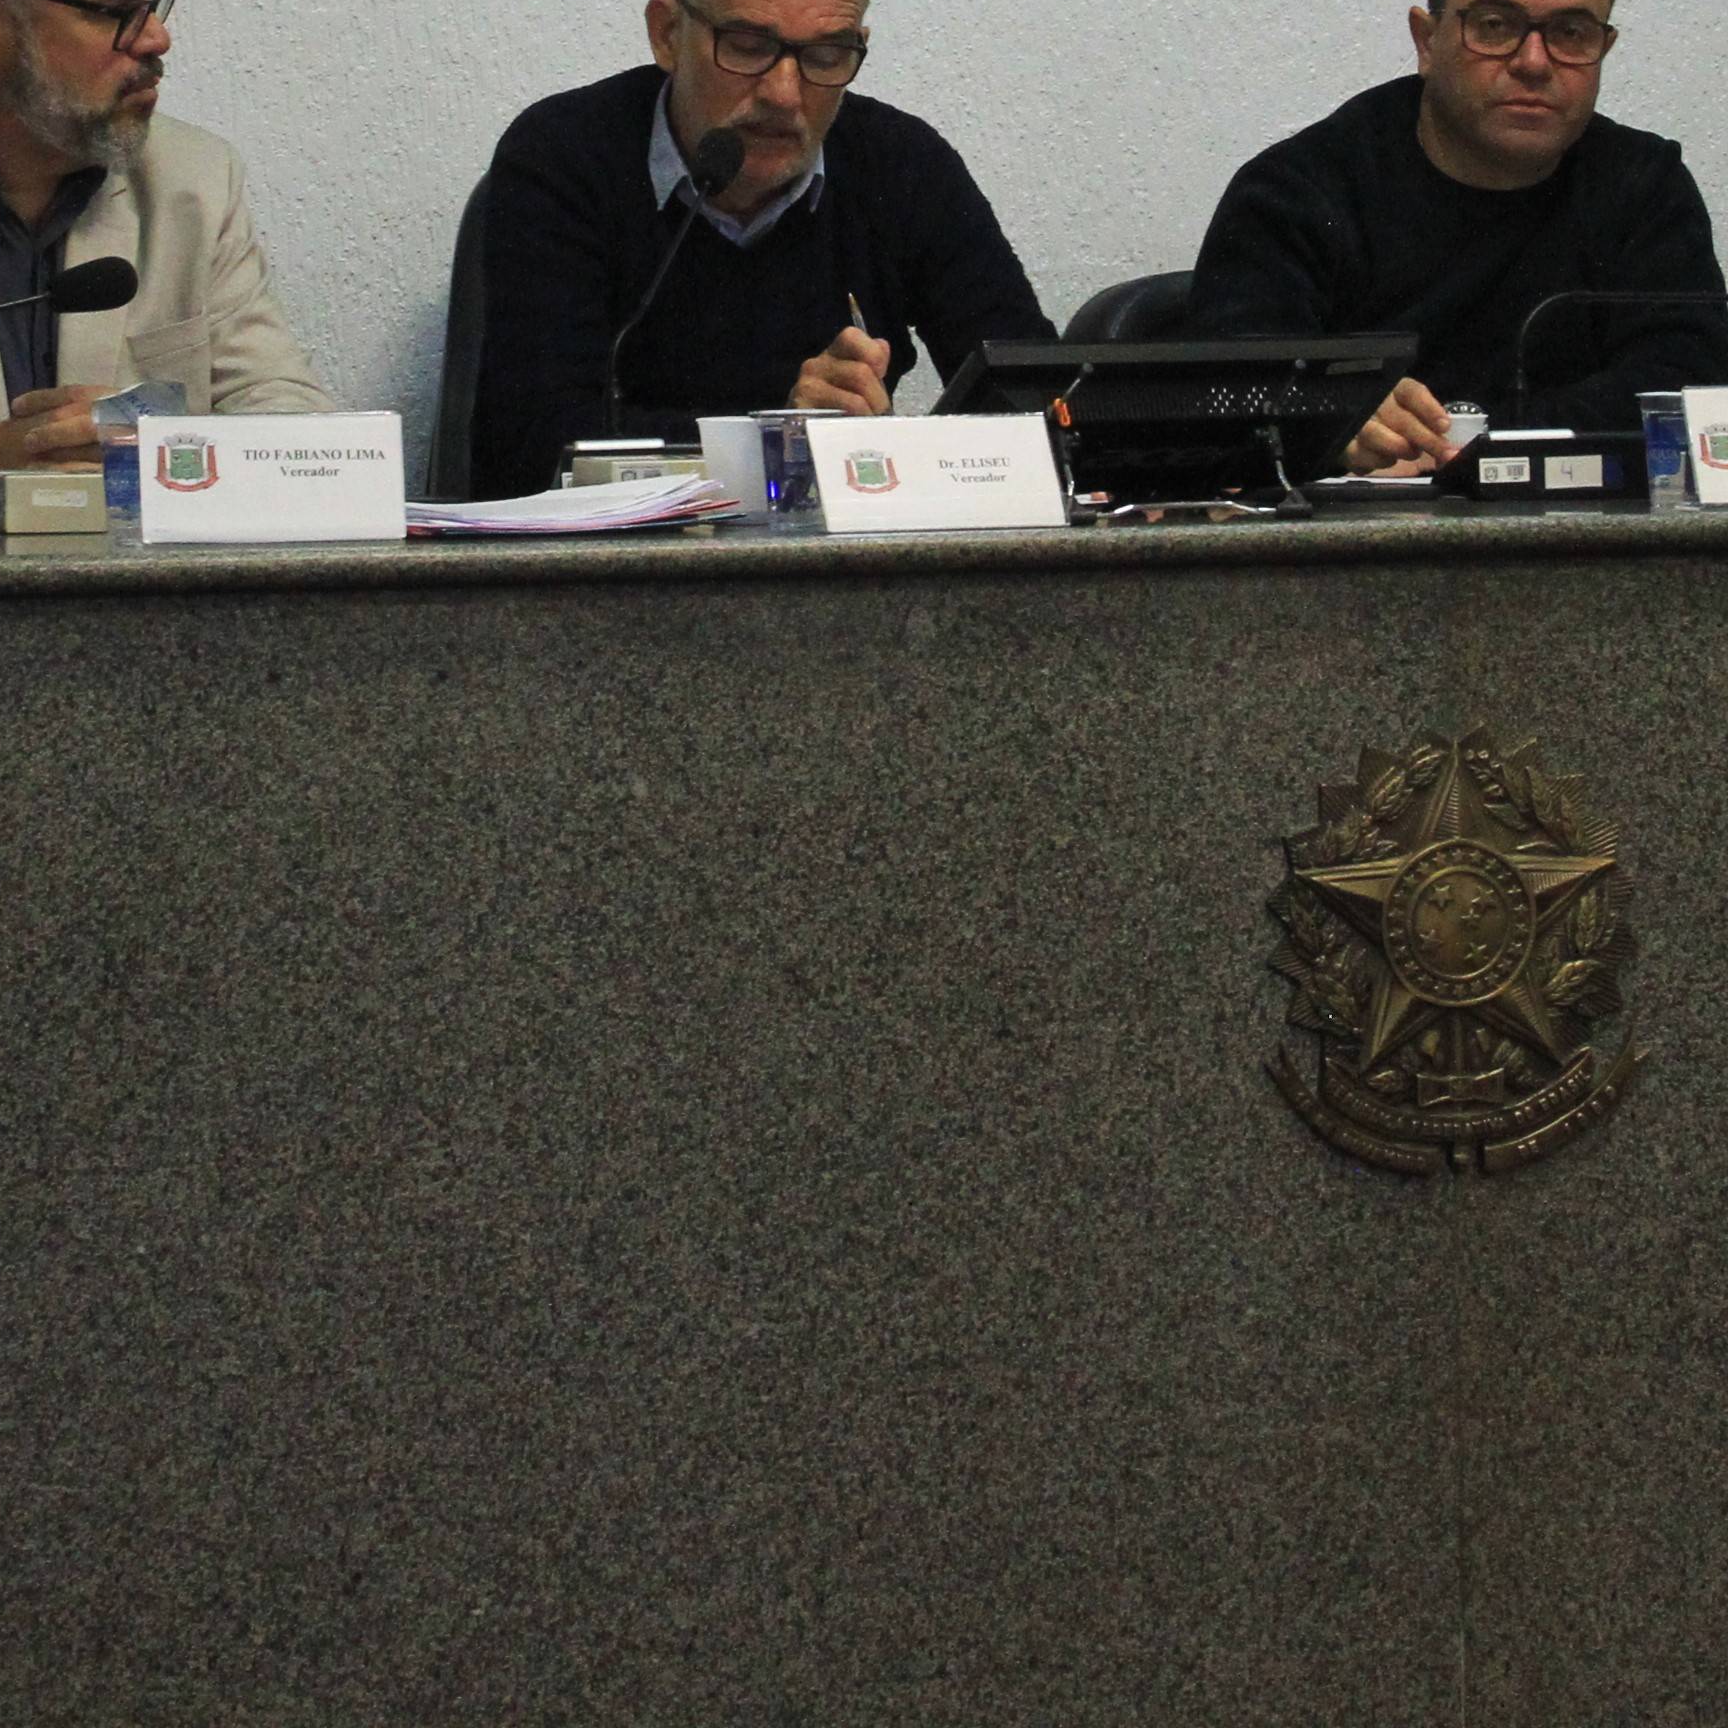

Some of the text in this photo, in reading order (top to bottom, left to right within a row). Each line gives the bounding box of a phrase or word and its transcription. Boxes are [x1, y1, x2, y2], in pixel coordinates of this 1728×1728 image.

[241, 448, 387, 462] TIO FABIANO LIMA
[938, 457, 1010, 469] Dr. ELISEU
[279, 465, 341, 478] Vereador
[951, 473, 1006, 483] Vereador
